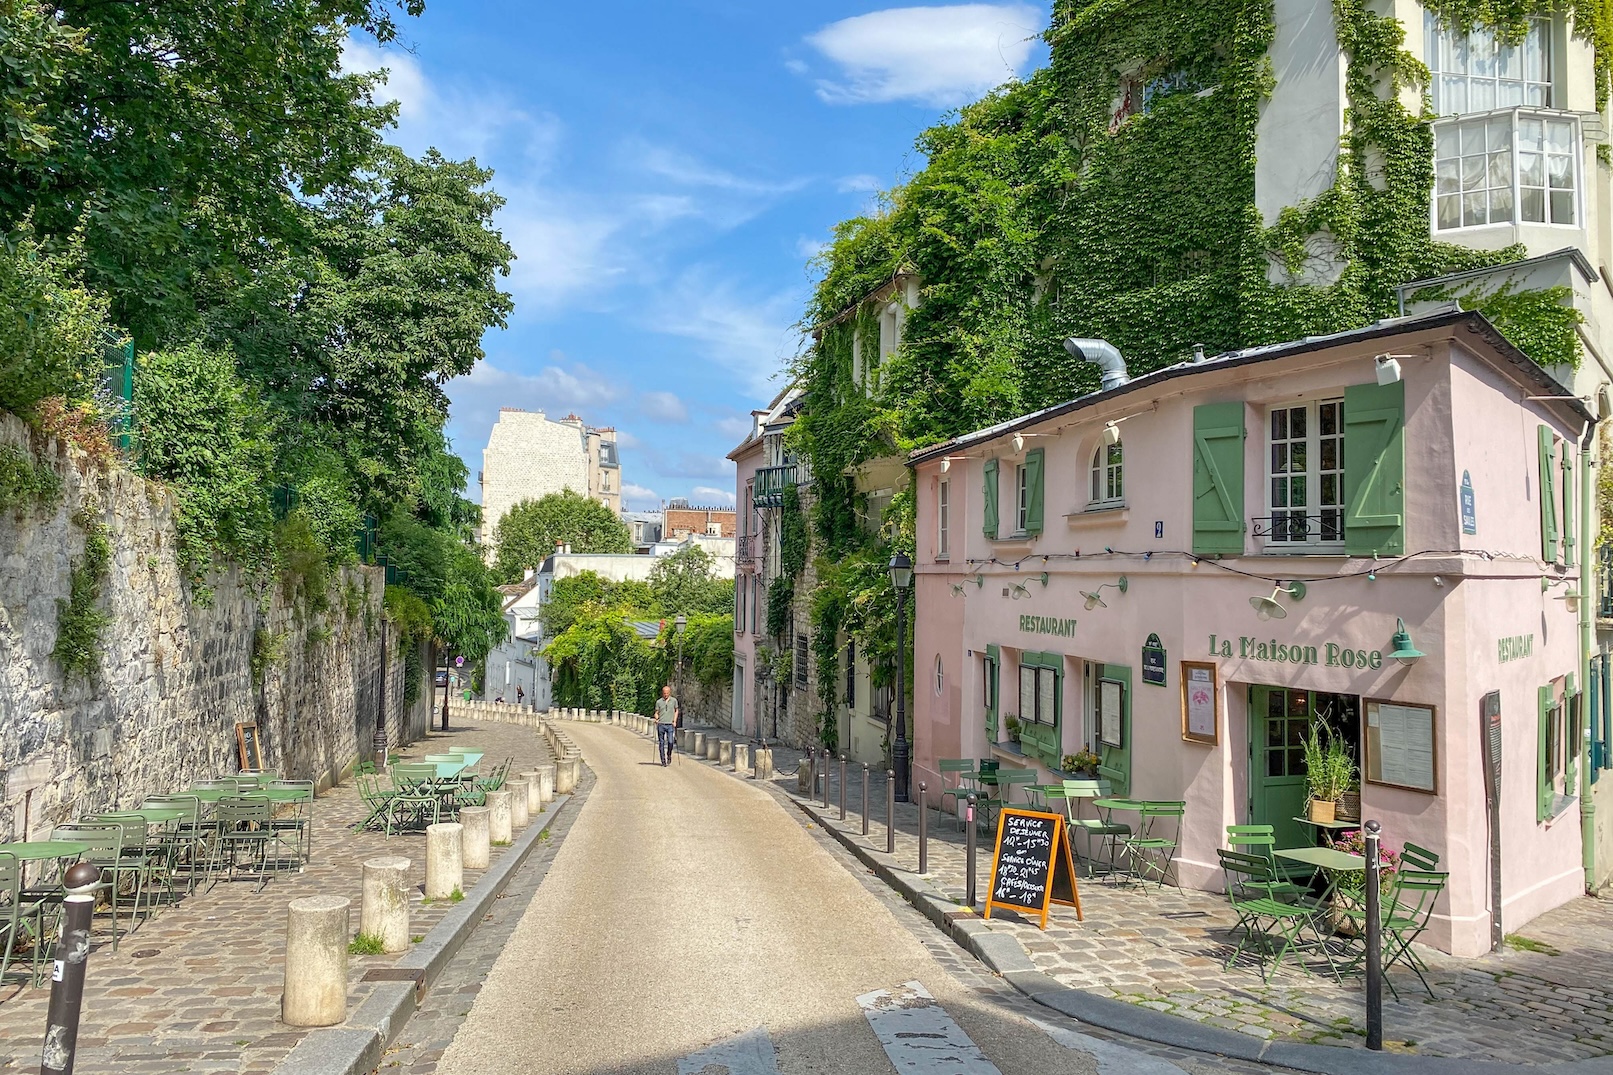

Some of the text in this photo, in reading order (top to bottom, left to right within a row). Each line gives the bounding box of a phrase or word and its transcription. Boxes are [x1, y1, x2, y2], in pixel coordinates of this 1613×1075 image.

[1019, 614, 1077, 638] RESTAURANT
[1208, 634, 1383, 670] La Maison Rose
[1498, 633, 1534, 664] RESTAURANT
